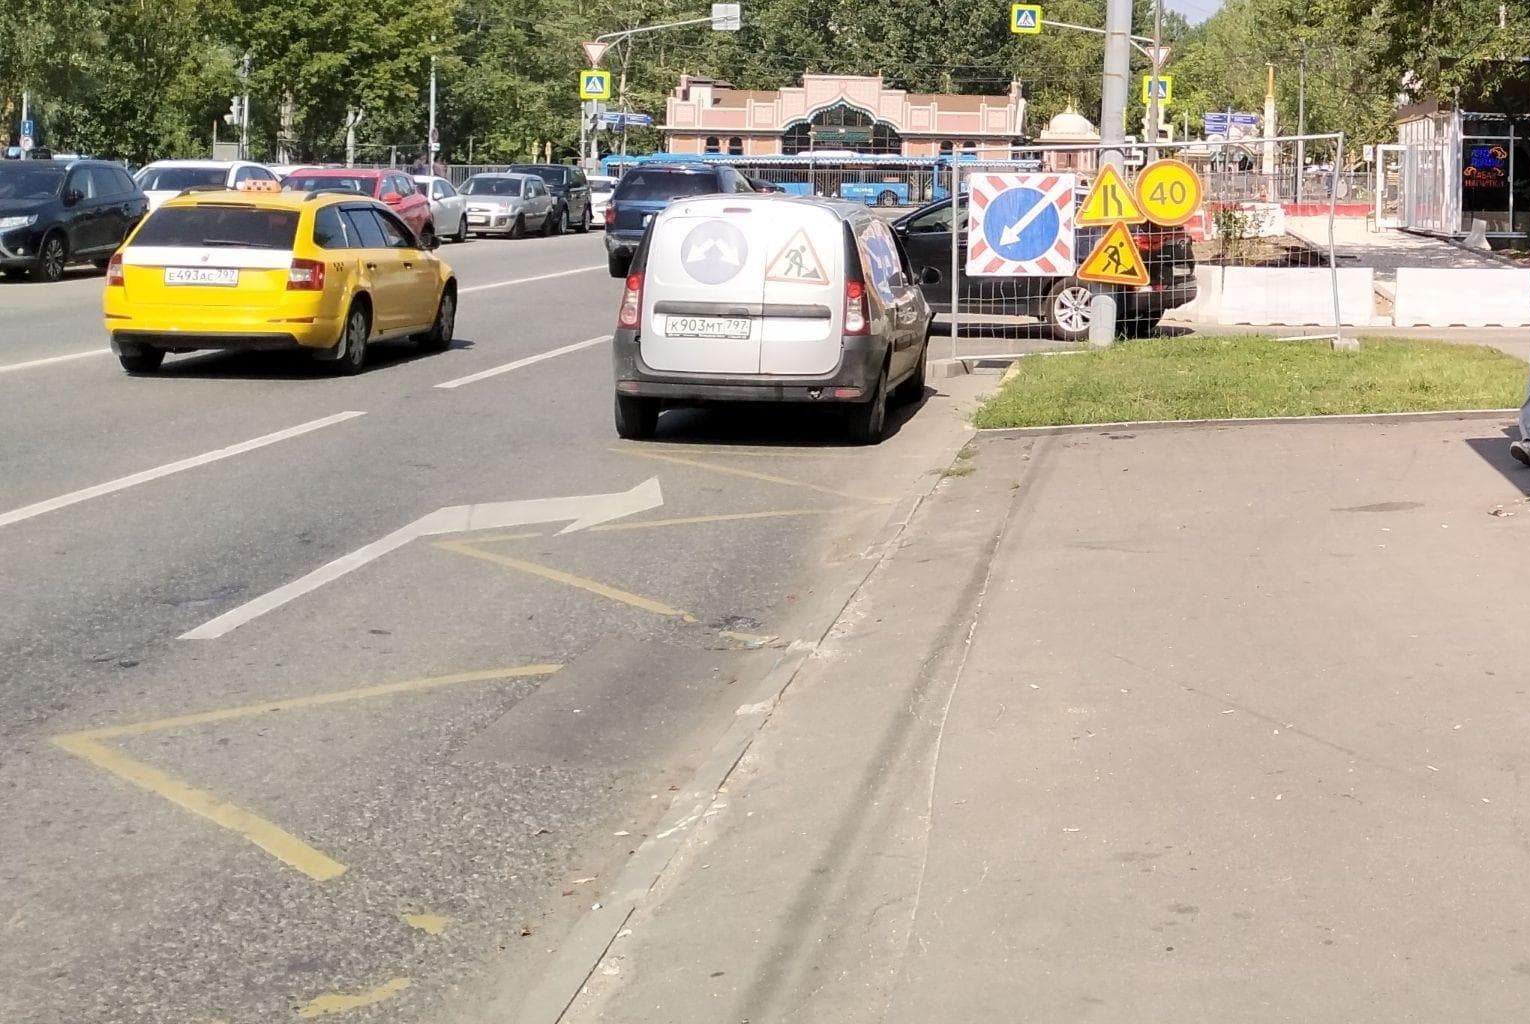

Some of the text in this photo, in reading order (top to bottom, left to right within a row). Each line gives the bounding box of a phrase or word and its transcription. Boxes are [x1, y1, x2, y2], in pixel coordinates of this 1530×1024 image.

[1149, 180, 1187, 206] 40
[671, 318, 747, 332] К903МТ 797
